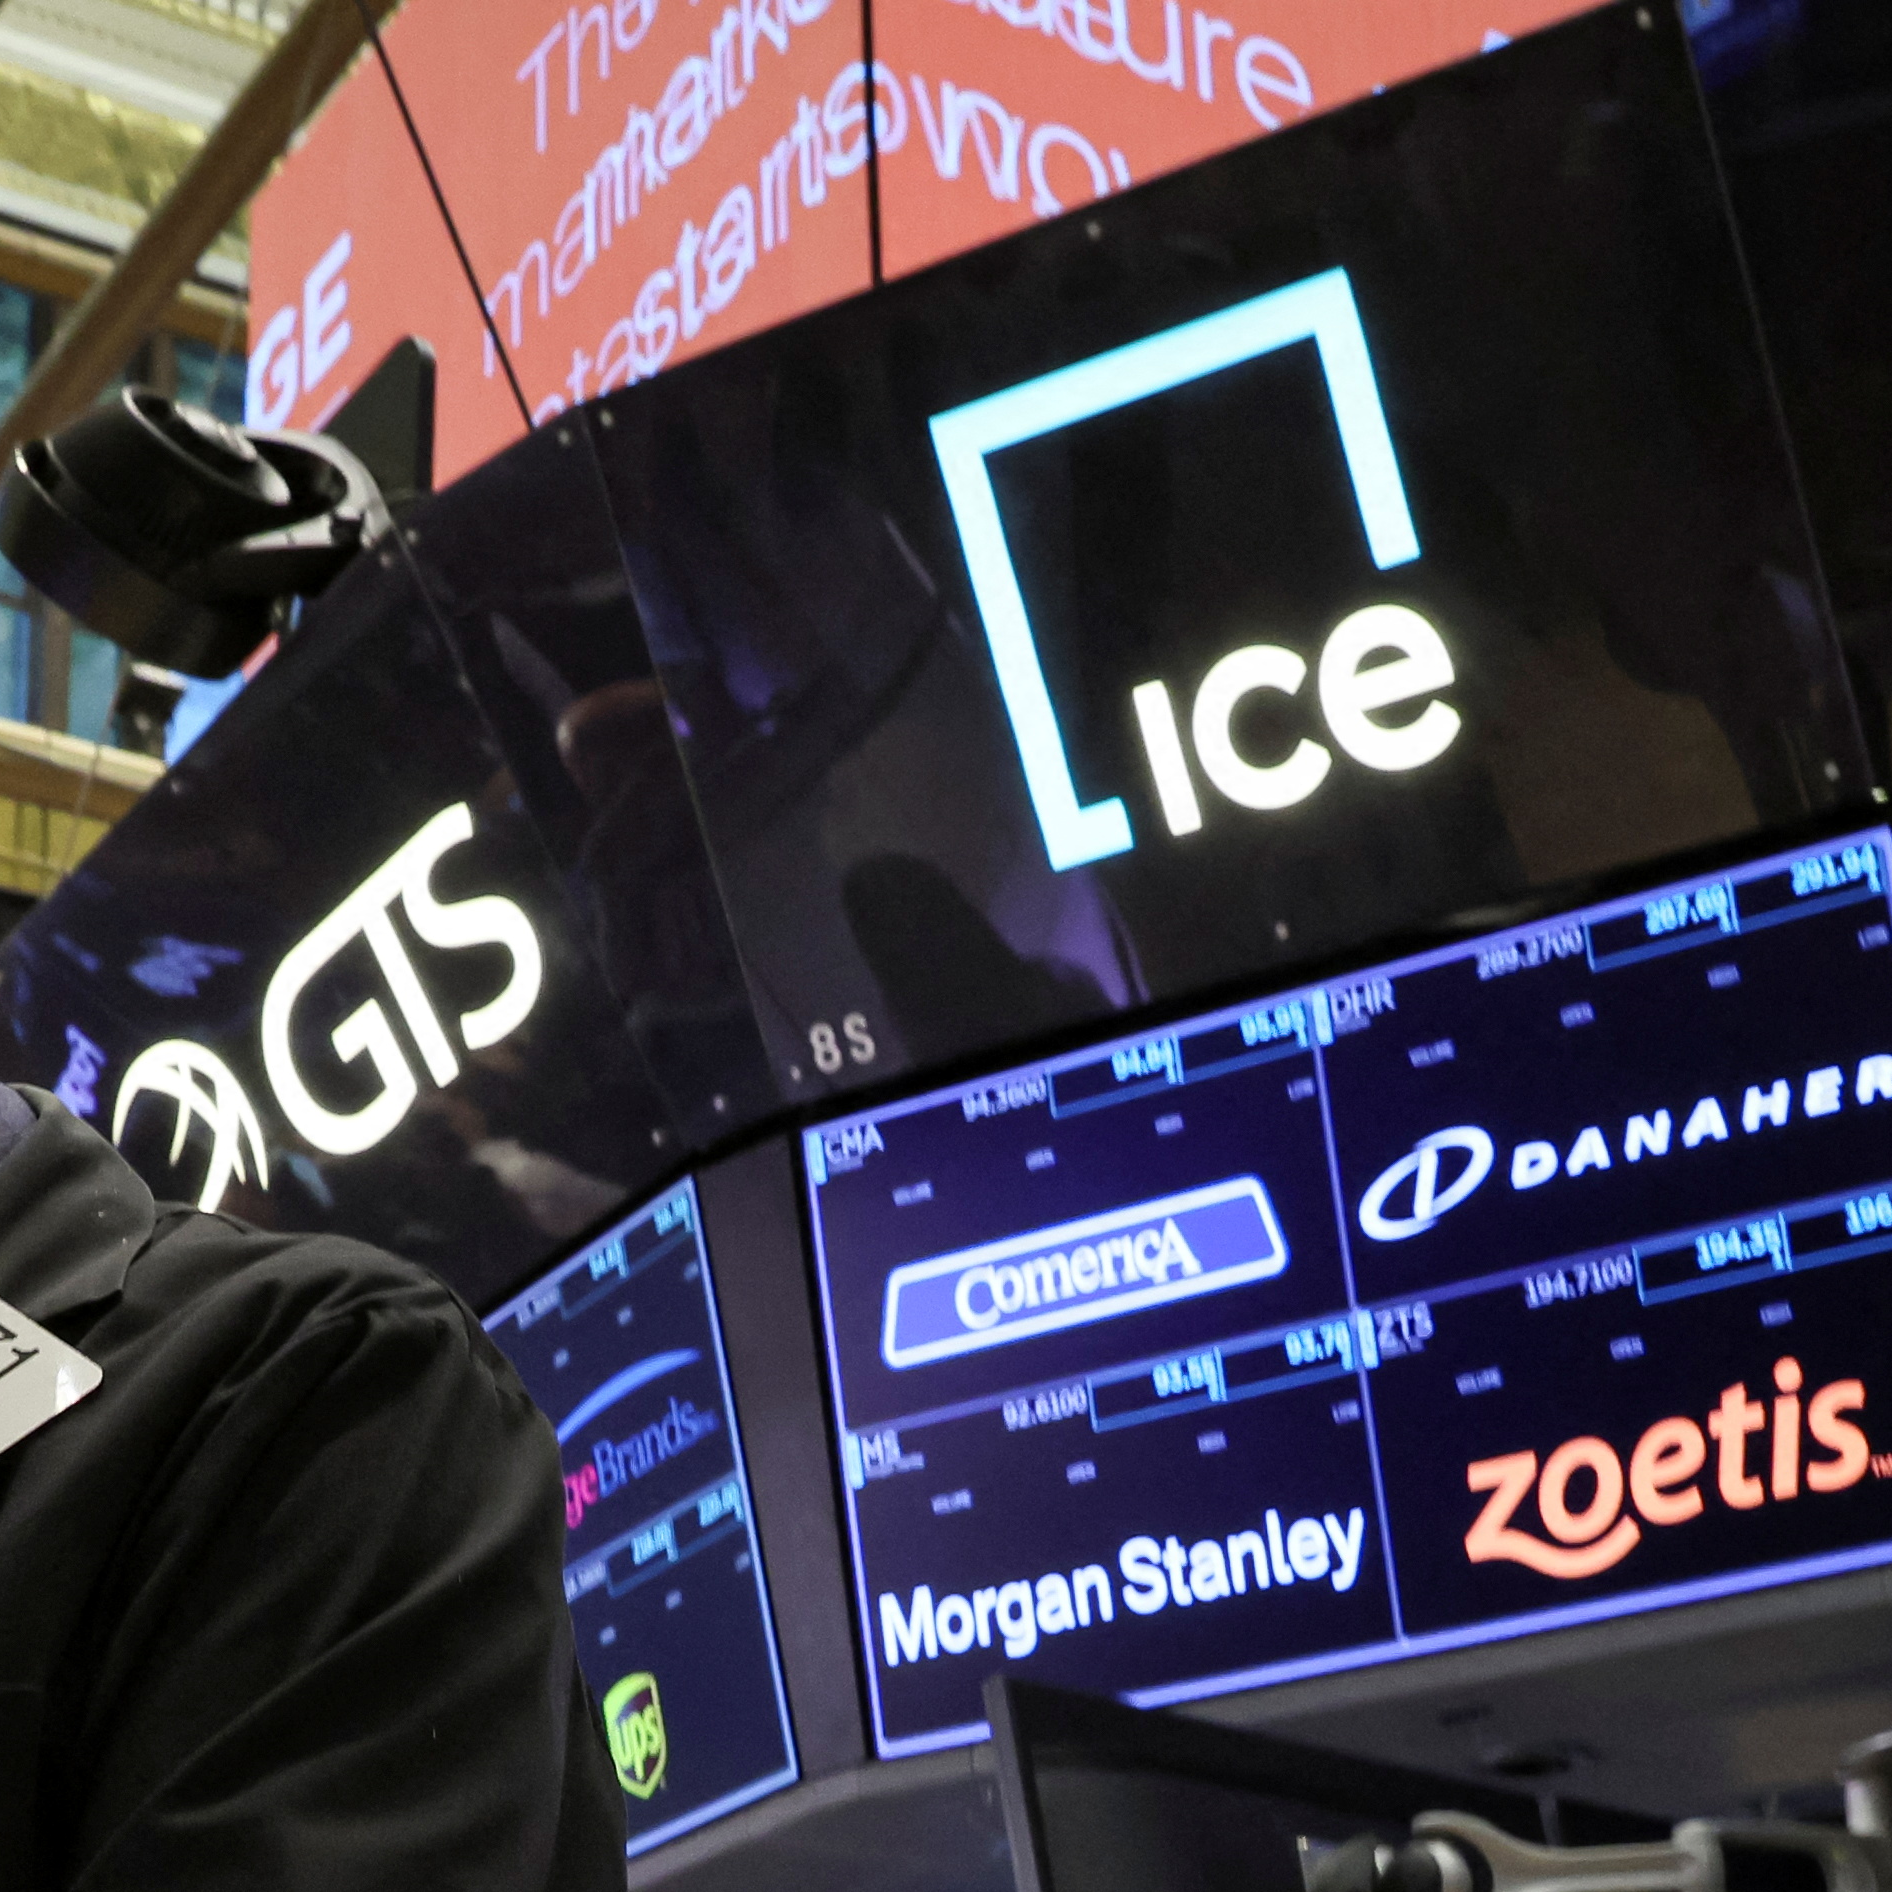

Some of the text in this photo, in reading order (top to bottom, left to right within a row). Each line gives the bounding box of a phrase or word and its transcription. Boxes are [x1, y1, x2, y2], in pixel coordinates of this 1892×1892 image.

[262, 801, 543, 1156] GTS
[1329, 975, 1396, 1018] DHR
[809, 1012, 877, 1074] 8S
[823, 1121, 885, 1163] CMA
[1464, 1354, 1871, 1580] zoetis
[878, 1507, 1364, 1667] Morgan Stanley
